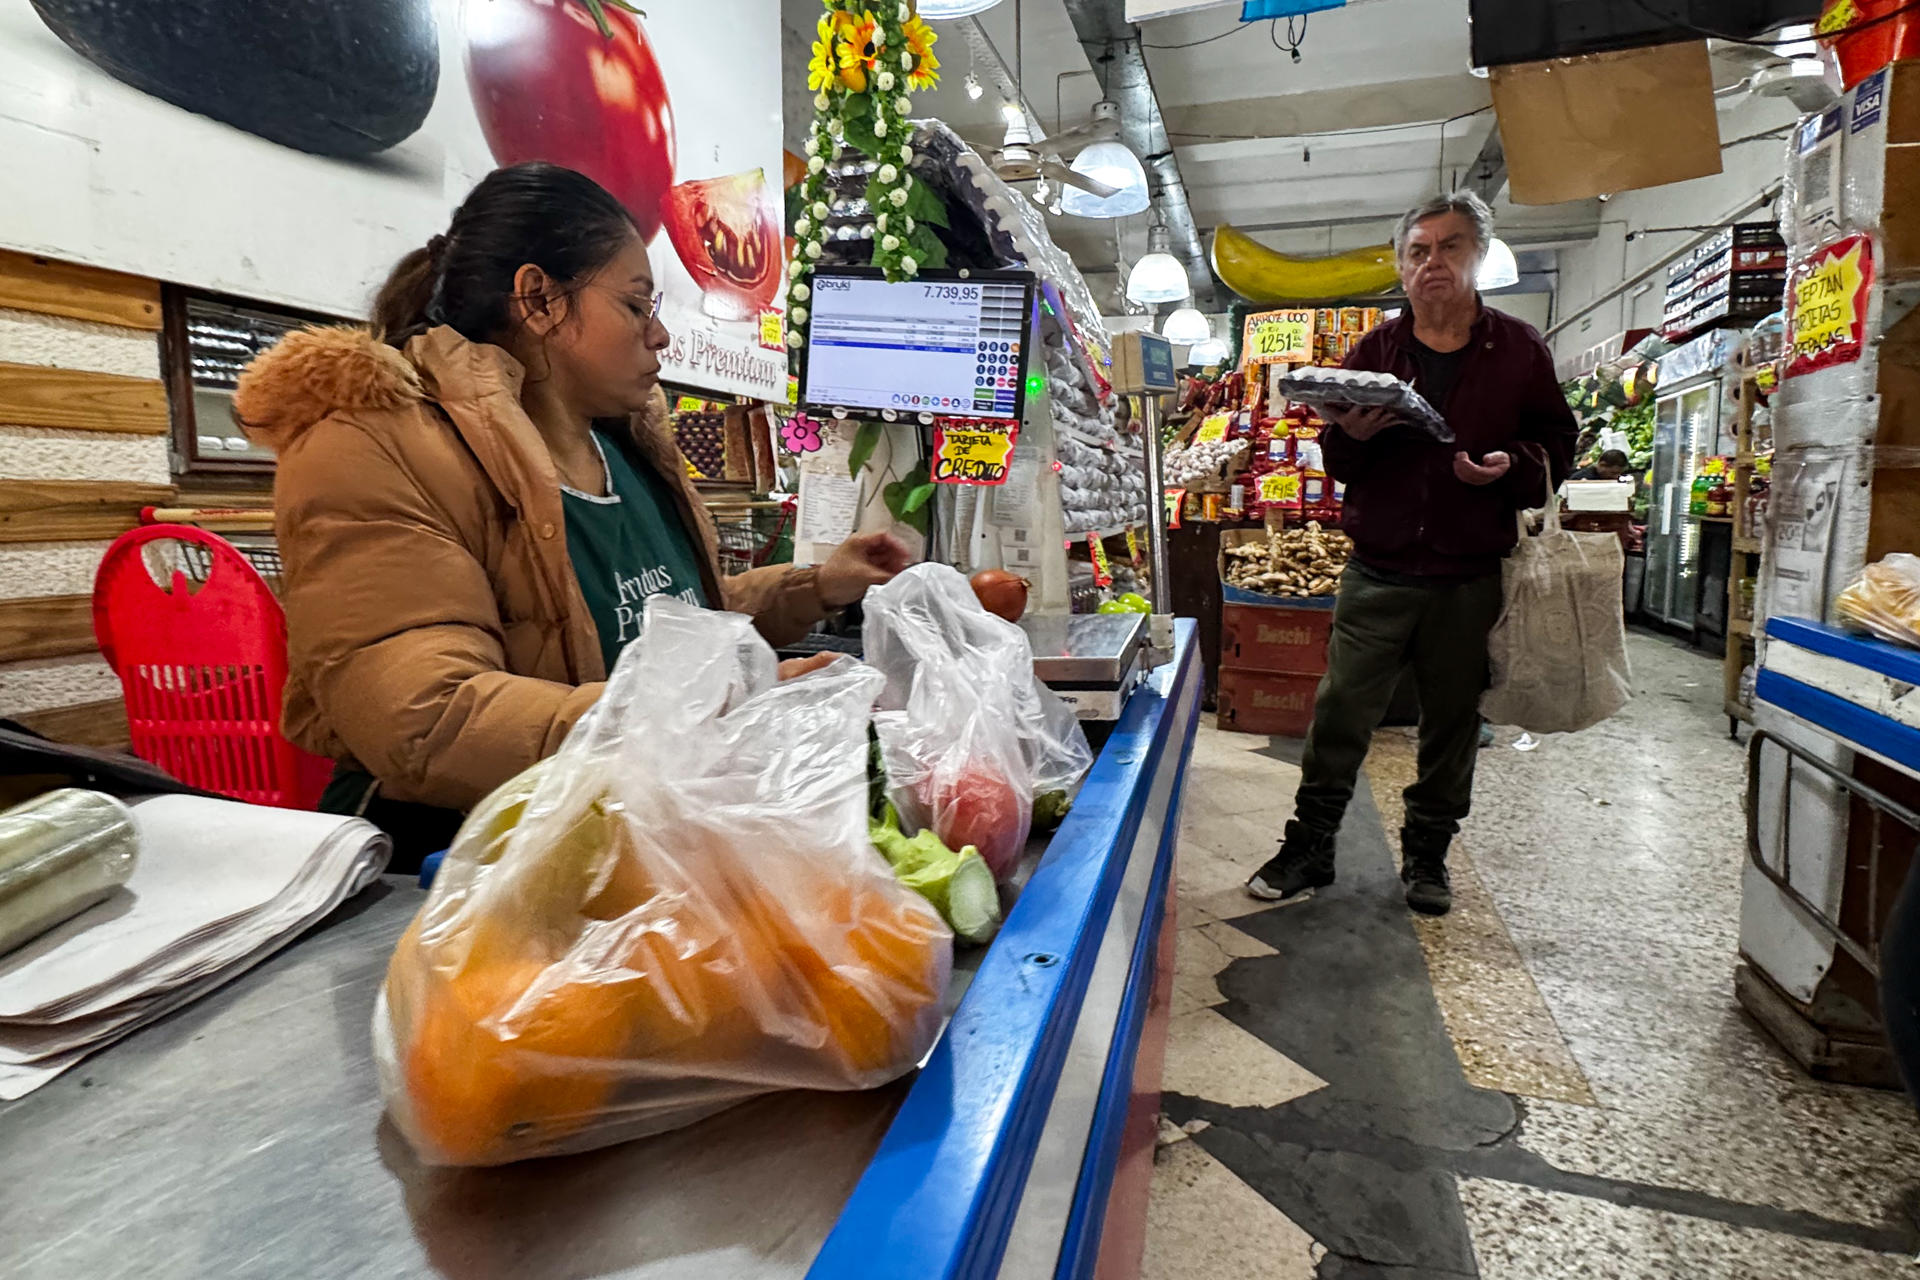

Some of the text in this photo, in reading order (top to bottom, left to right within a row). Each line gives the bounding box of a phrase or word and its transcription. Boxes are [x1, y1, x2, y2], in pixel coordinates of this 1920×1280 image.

[1855, 94, 1880, 116] VISA
[924, 285, 979, 300] 7.739,95
[1794, 267, 1844, 307] CEPTAN
[1260, 332, 1291, 354] 1251
[690, 329, 777, 384] Premium
[945, 434, 992, 449] TARJETA
[953, 445, 970, 456] DE
[935, 458, 1007, 480] CREDITO
